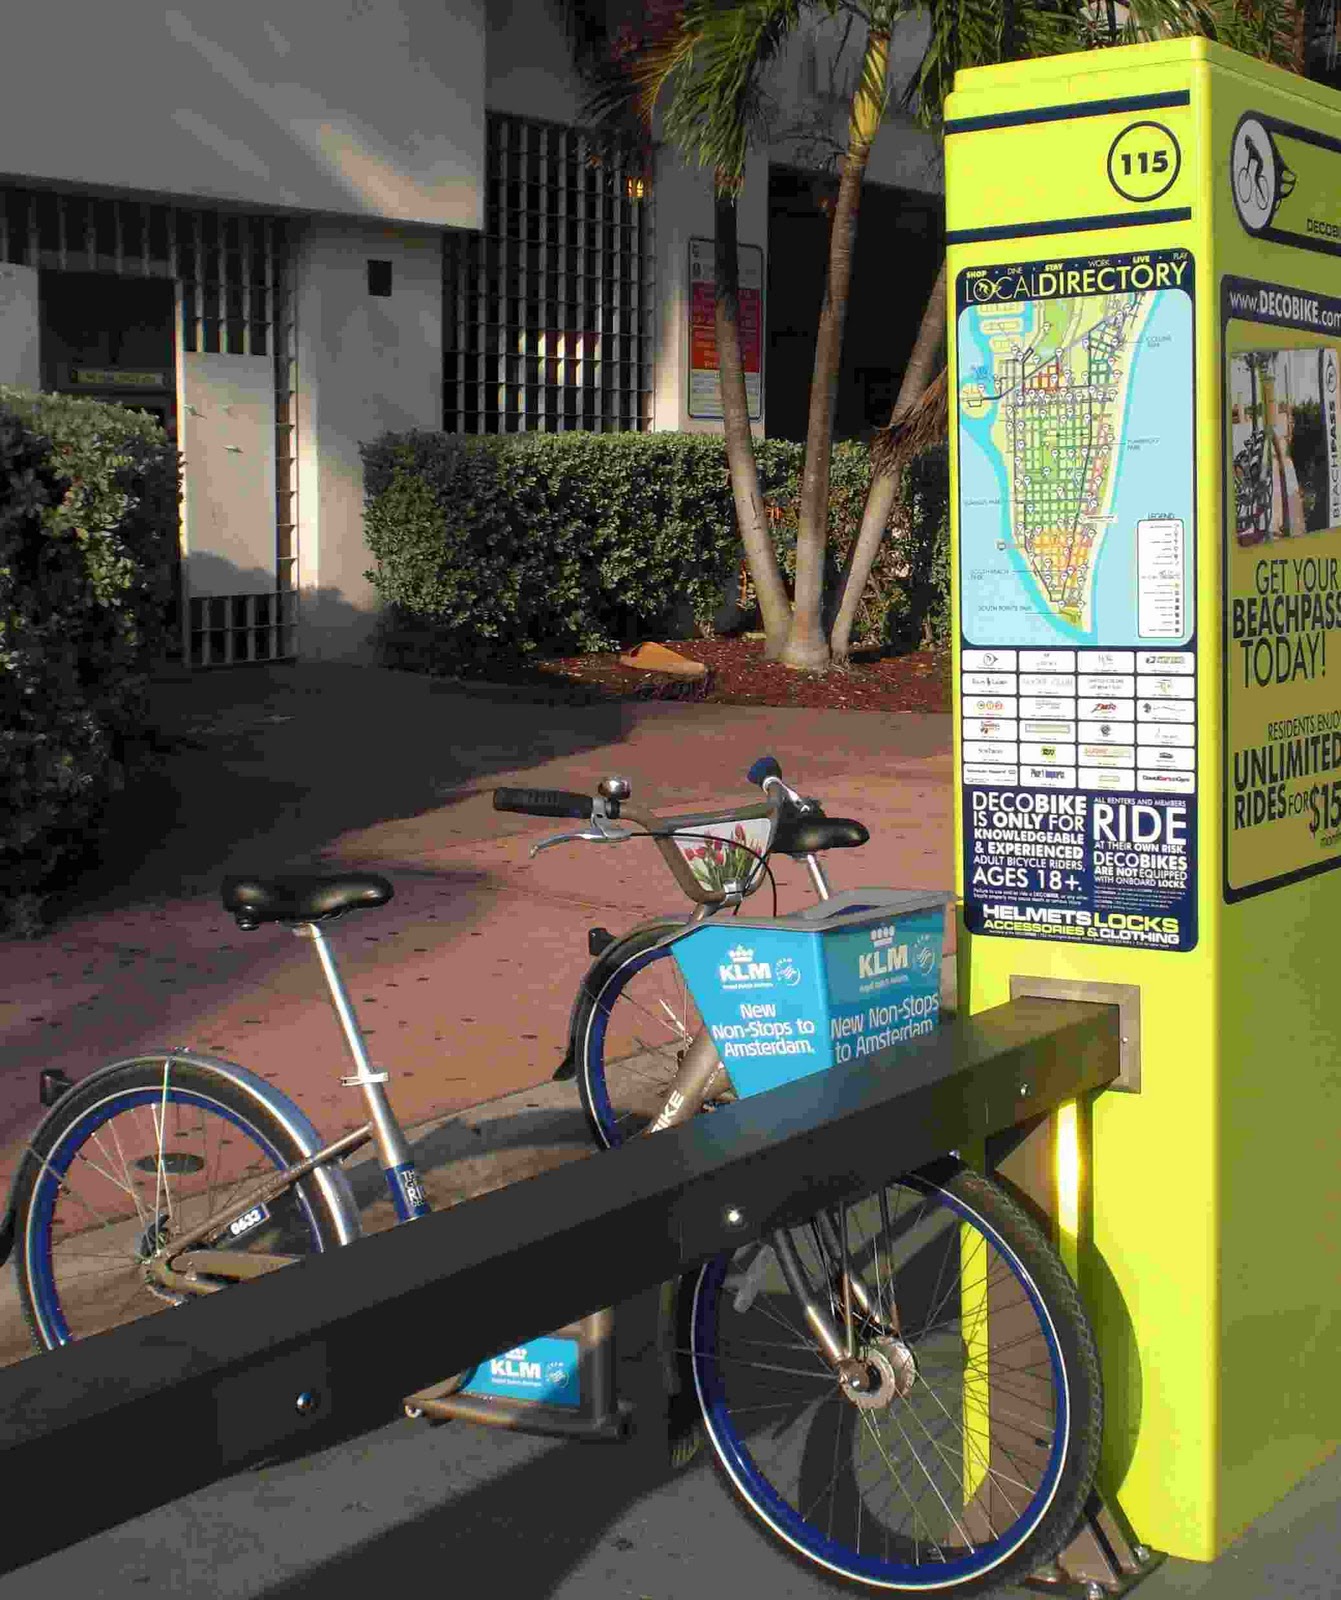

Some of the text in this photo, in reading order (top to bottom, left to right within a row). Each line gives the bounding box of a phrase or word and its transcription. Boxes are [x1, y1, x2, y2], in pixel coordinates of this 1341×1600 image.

[1120, 150, 1169, 176] 115
[1132, 255, 1150, 264] LIVE
[1256, 557, 1339, 595] GET YOUR
[1240, 630, 1326, 688] TODAY!
[1267, 710, 1341, 741] RESIDENTS ENJO
[1234, 731, 1341, 792] UNLIMITED
[972, 791, 1087, 815] DECOBIKE
[1234, 783, 1286, 830] RIDES
[1288, 791, 1309, 816] FOR
[973, 811, 1085, 832] IS ONLY FOR
[1093, 804, 1187, 845] RIDE
[974, 828, 1085, 845] KNOWLEDGEABLE
[1093, 841, 1187, 854] AT THEIR OWN RISK.
[974, 841, 1084, 859] & EXPERIENCED
[1093, 851, 1188, 871] DECOBIKES
[973, 855, 1004, 866] ADULT
[1006, 857, 1047, 868] BICYCLE
[972, 866, 1029, 888] AGES
[1094, 867, 1187, 881] ARE NOT EQUIPPED
[1094, 876, 1114, 884] WITH
[1115, 877, 1156, 887] ONBOARD
[982, 904, 1179, 934] HELMETS LOCKS
[983, 919, 1086, 936] ACCESSORIES
[1099, 929, 1180, 945] CLOTHING
[719, 962, 772, 982] KLM
[859, 944, 908, 979] KLM
[740, 1003, 776, 1019] New
[830, 992, 939, 1041] New Non-Stops
[711, 1018, 815, 1041] Non-Stops to
[724, 1039, 816, 1058] Amsterdam.
[835, 1041, 851, 1064] to
[491, 1359, 542, 1379] KLM
